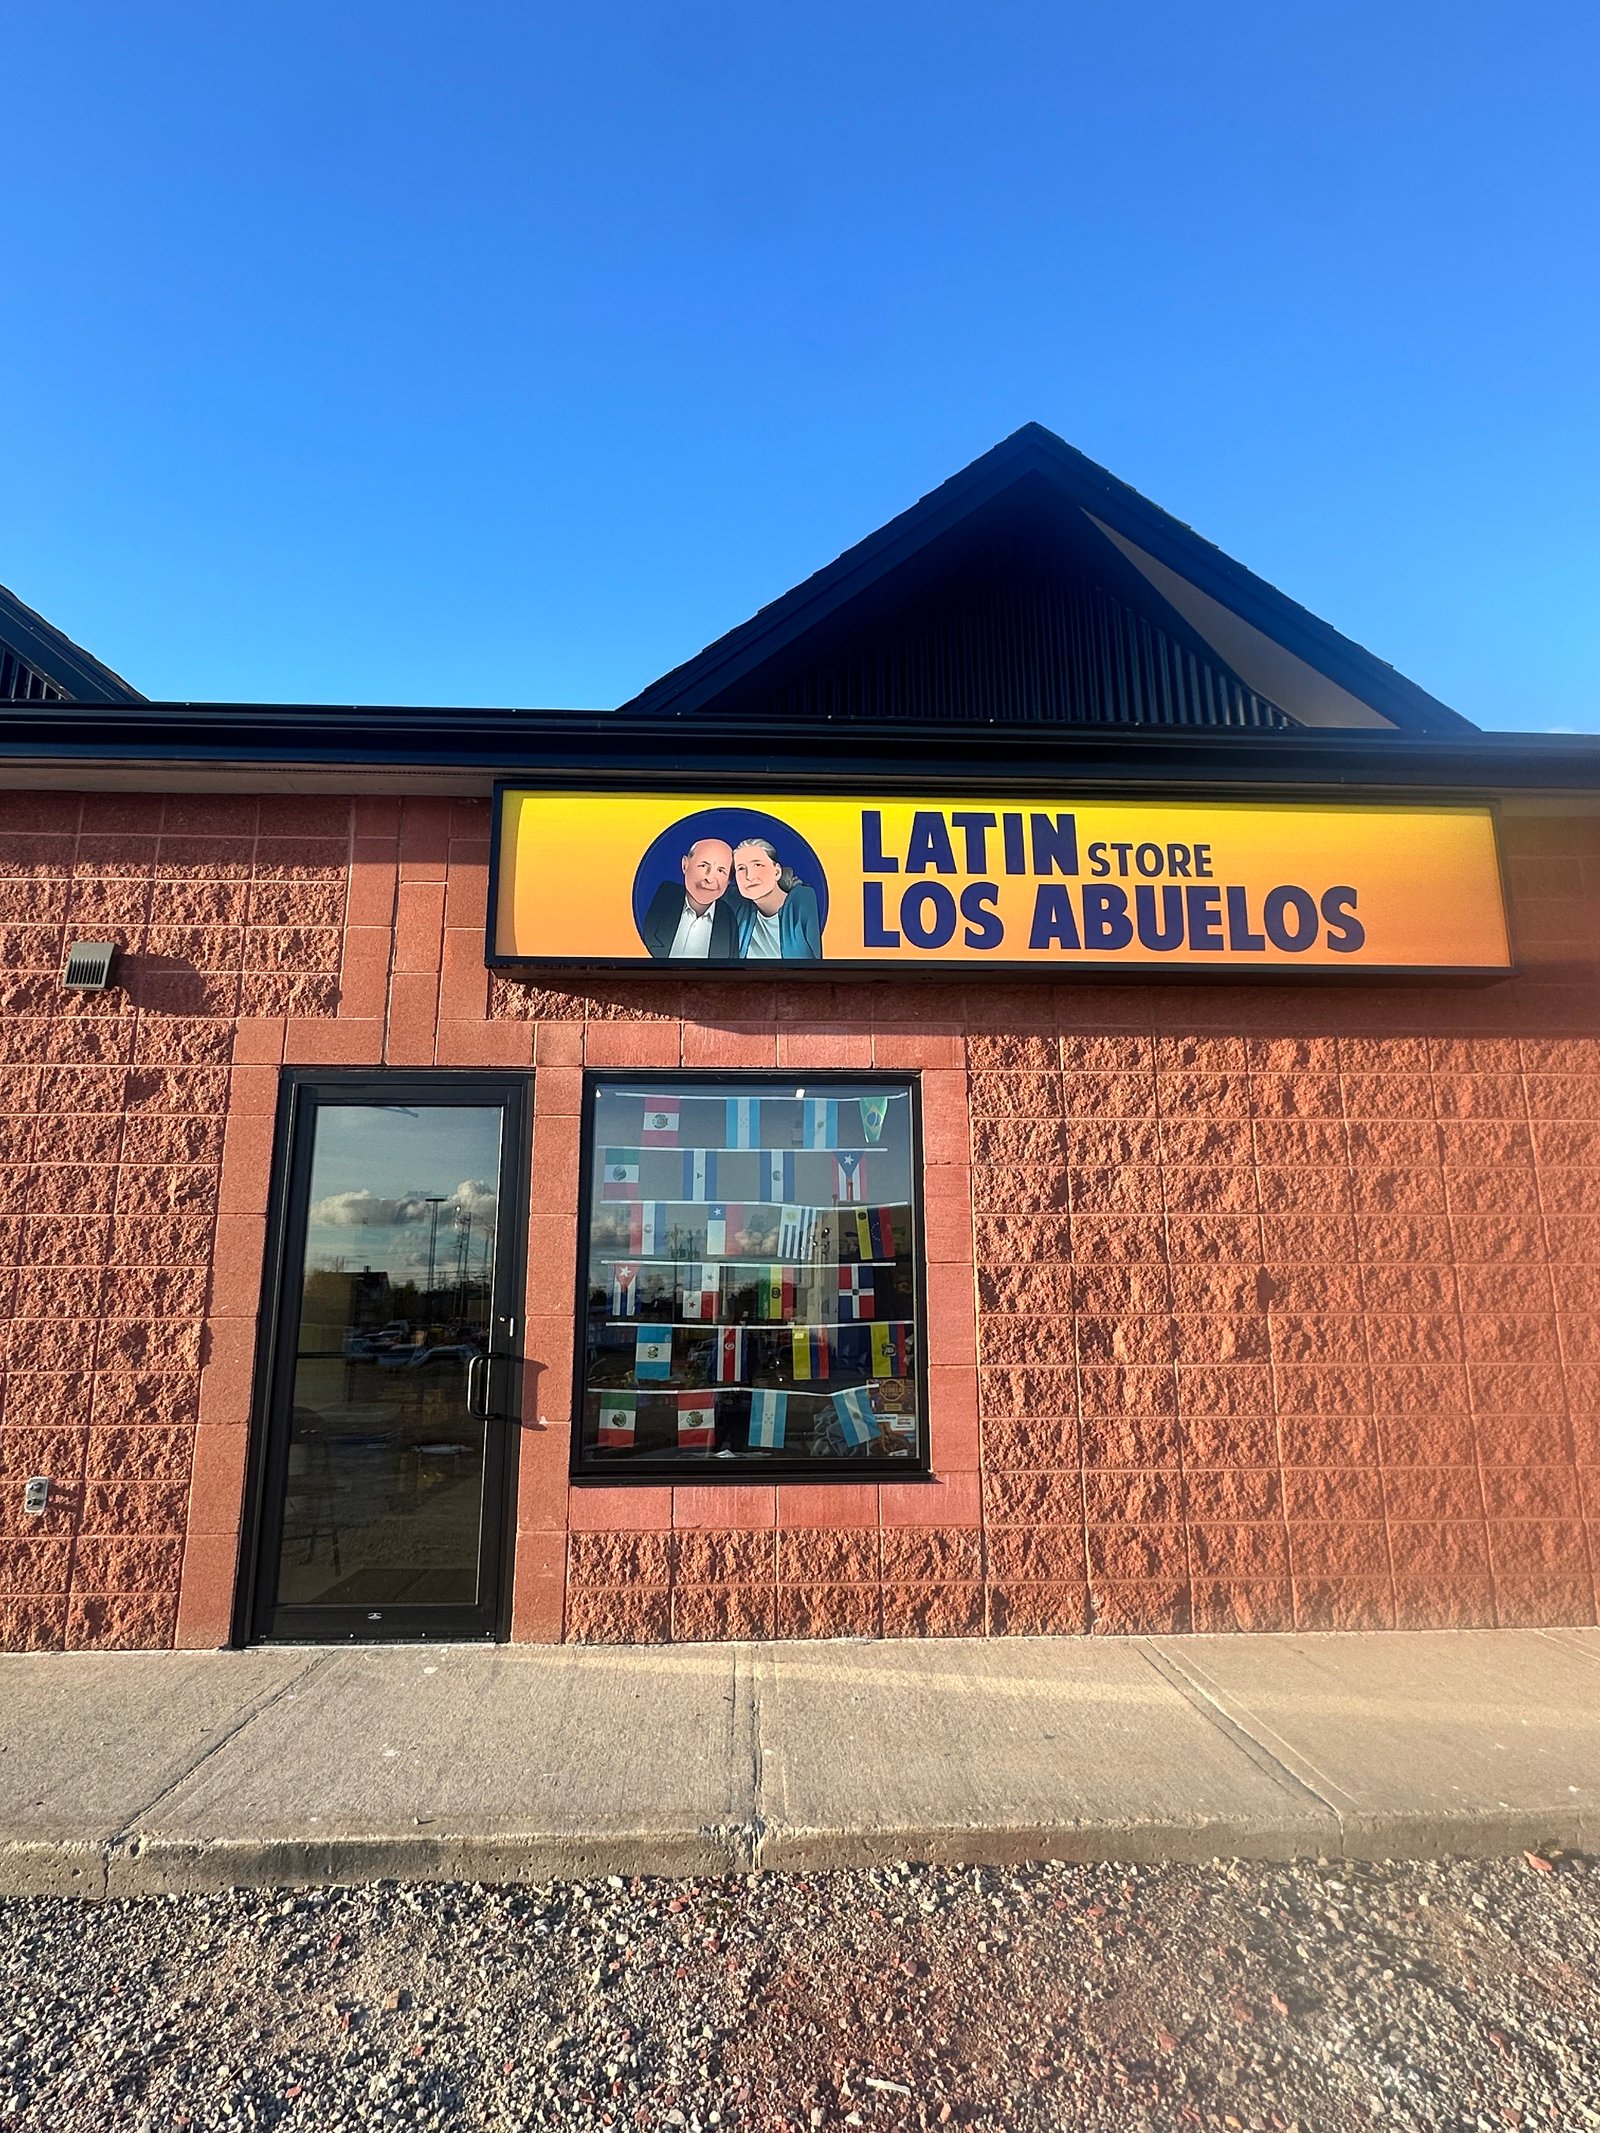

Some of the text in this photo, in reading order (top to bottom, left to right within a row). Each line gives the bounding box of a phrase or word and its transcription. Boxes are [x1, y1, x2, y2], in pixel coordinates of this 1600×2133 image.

[861, 810, 1214, 877] LATIN STORE
[862, 880, 1365, 953] LOS ABUELOS
